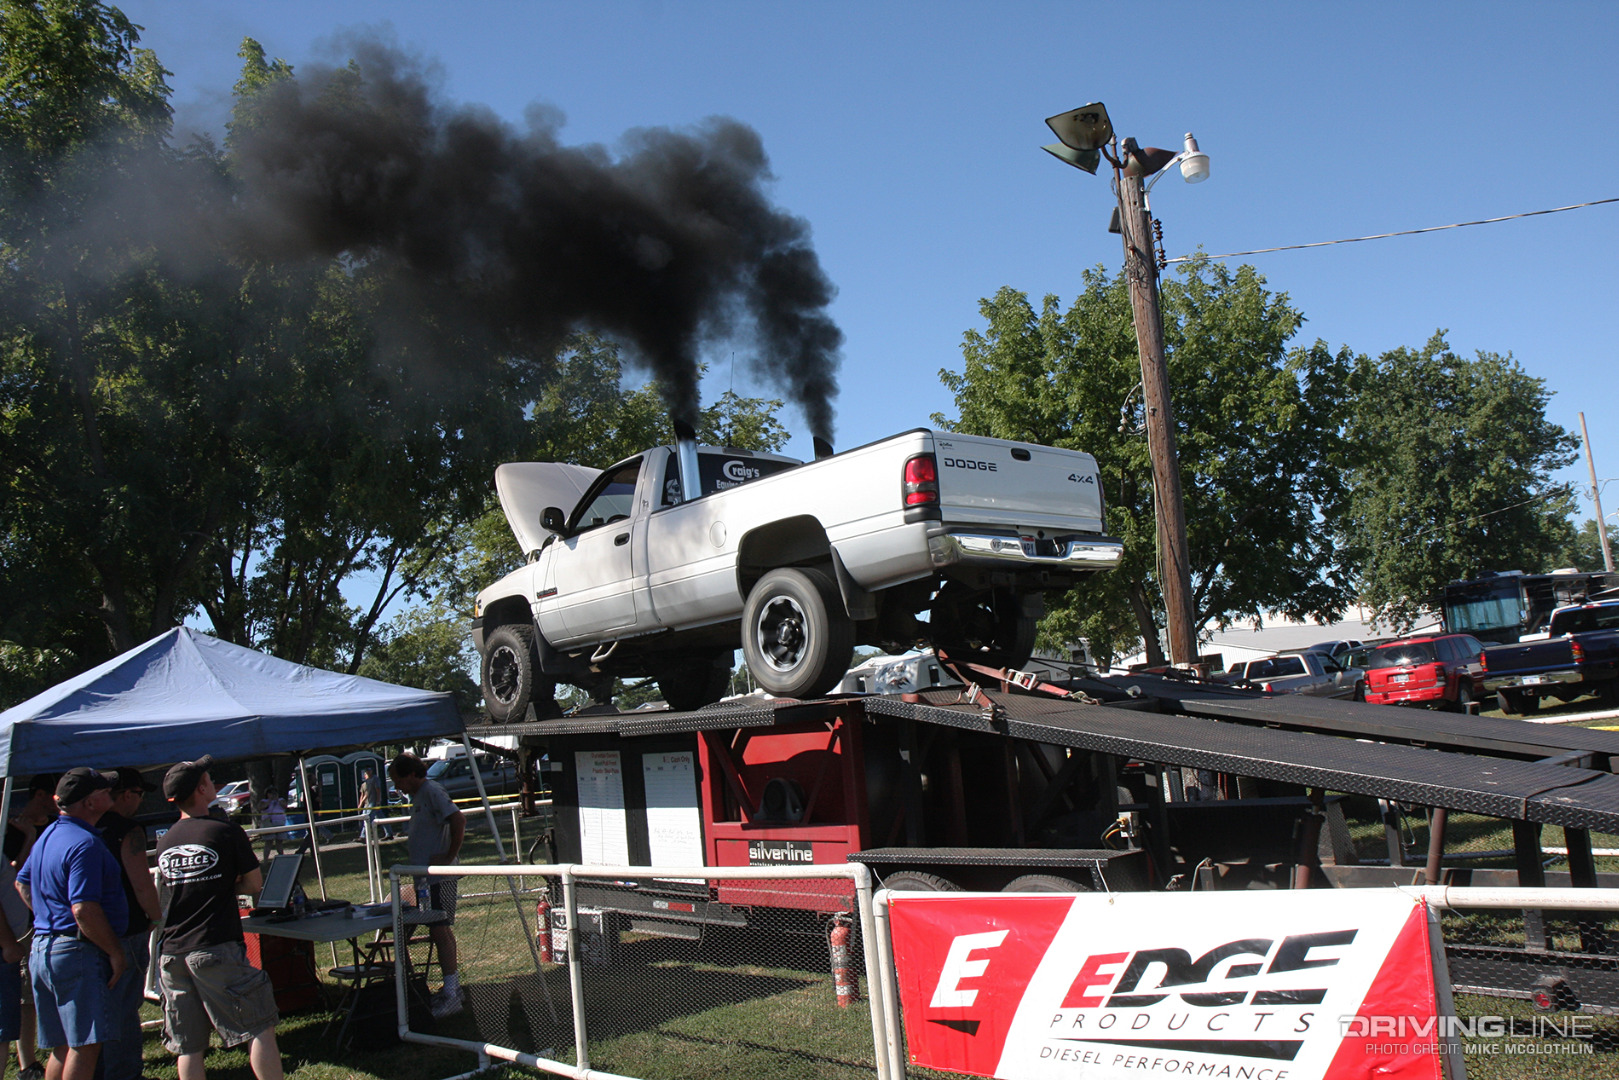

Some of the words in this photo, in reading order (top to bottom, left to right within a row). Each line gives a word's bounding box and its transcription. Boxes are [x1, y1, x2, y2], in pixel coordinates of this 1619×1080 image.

[722, 460, 760, 480] Craig's
[944, 457, 998, 472] DODGE
[170, 854, 209, 867] FLEECE
[749, 841, 813, 861] silverline
[929, 929, 1010, 1008] E
[1059, 928, 1359, 1008] EDGE
[1050, 1012, 1315, 1033] PRODUCTS
[1039, 1046, 1102, 1065] DIESEL
[1112, 1053, 1289, 1080] PERFORMANCE
